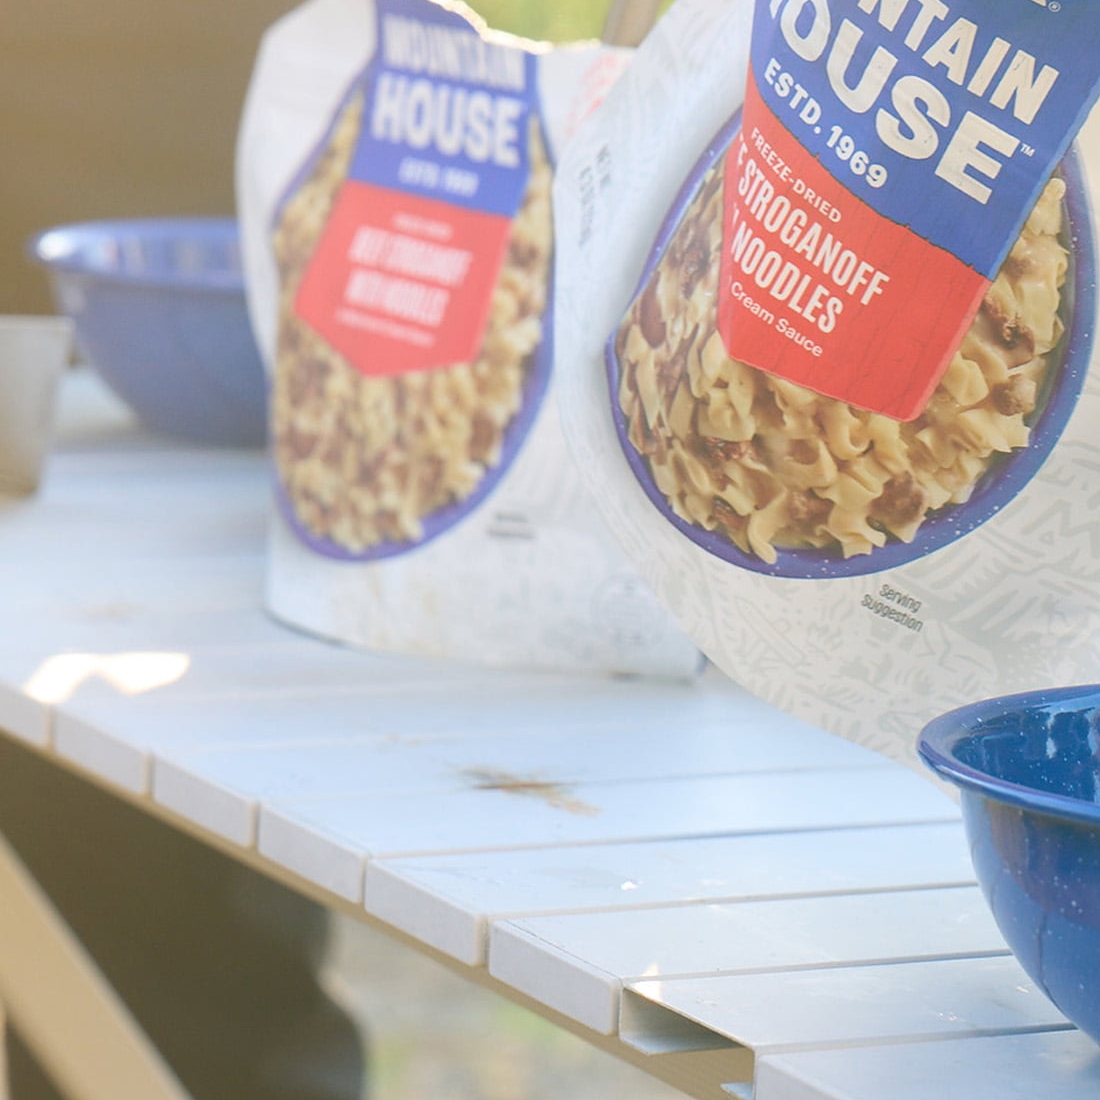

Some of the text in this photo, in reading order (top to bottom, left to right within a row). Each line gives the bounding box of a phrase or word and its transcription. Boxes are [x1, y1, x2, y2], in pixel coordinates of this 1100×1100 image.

[370, 71, 523, 169] HOUSE
[763, 57, 822, 135] ESTD.
[826, 125, 888, 188] 1969
[751, 127, 842, 224] FREEZE-DRIED
[731, 220, 844, 334] NOODLES
[737, 158, 890, 306] STROGANOFF
[731, 281, 824, 357] Cream Sauce
